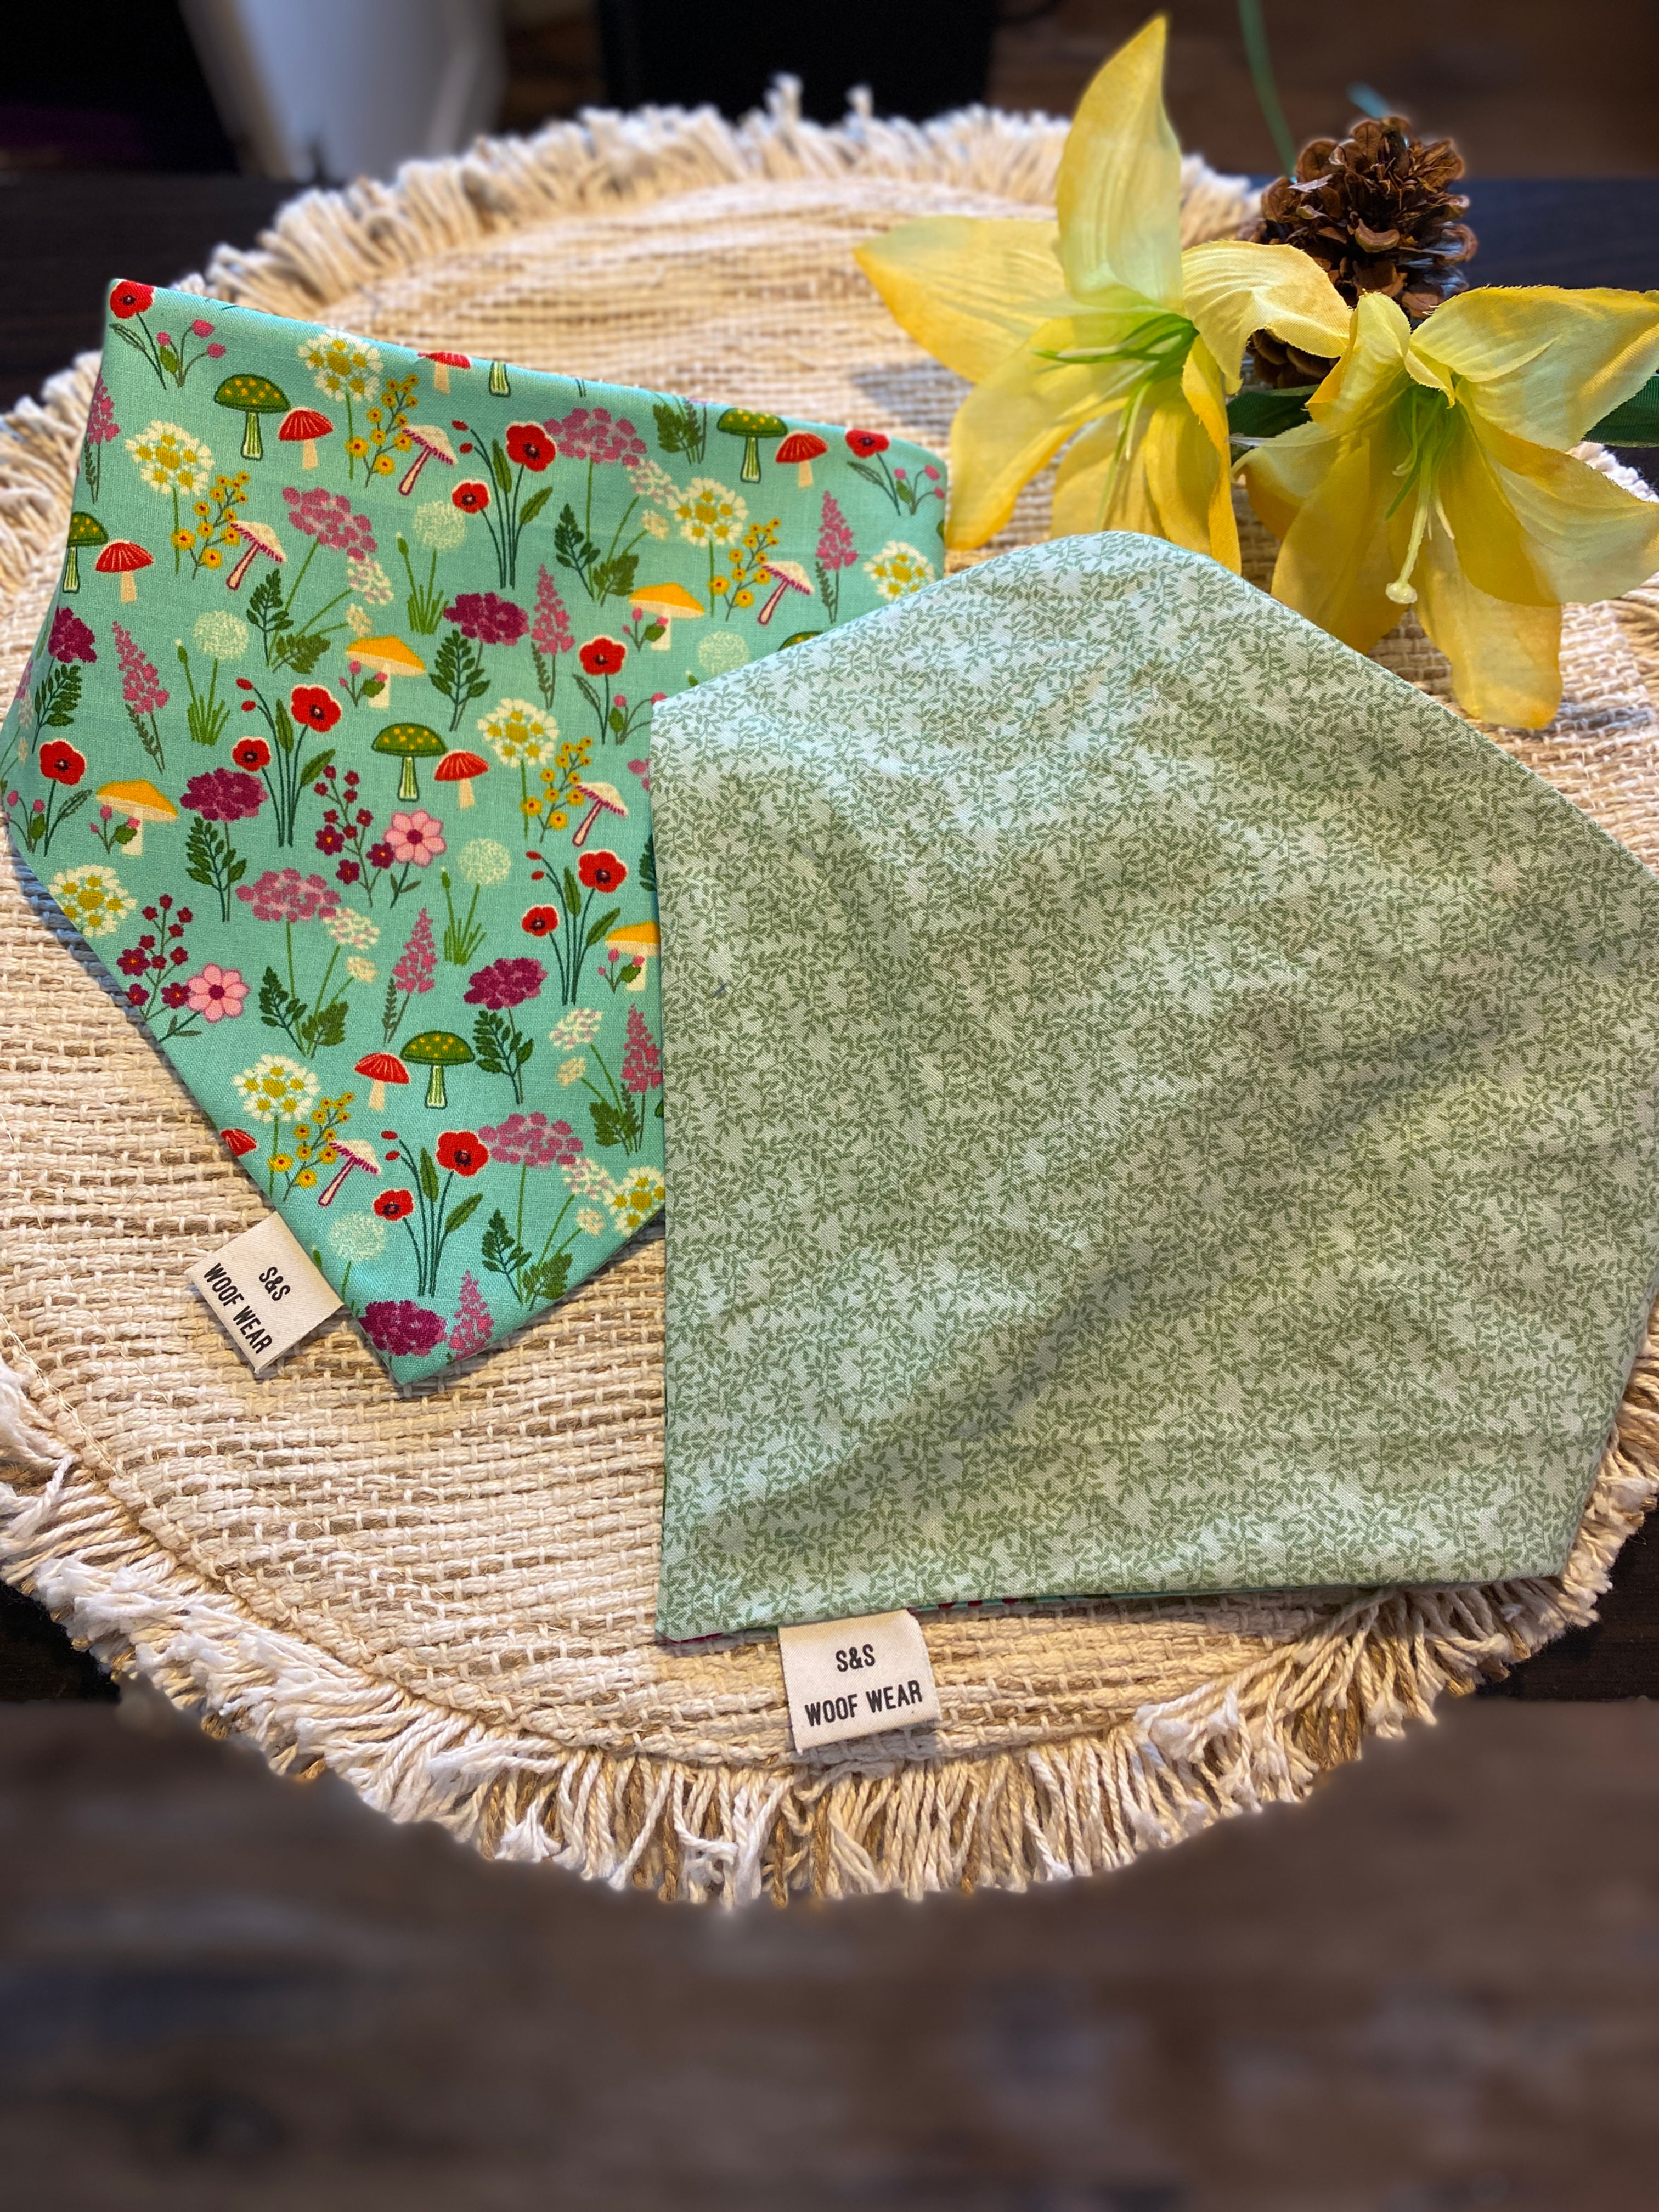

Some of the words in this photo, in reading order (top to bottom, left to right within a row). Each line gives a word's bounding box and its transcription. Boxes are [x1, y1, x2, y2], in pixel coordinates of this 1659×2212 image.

[258, 1266, 291, 1301] S&S
[204, 1262, 244, 1307] WOOF
[233, 1305, 273, 1354] WEAR
[835, 1644, 876, 1672] S&S
[804, 1694, 857, 1726] WOOF
[865, 1680, 923, 1713] WEAR
